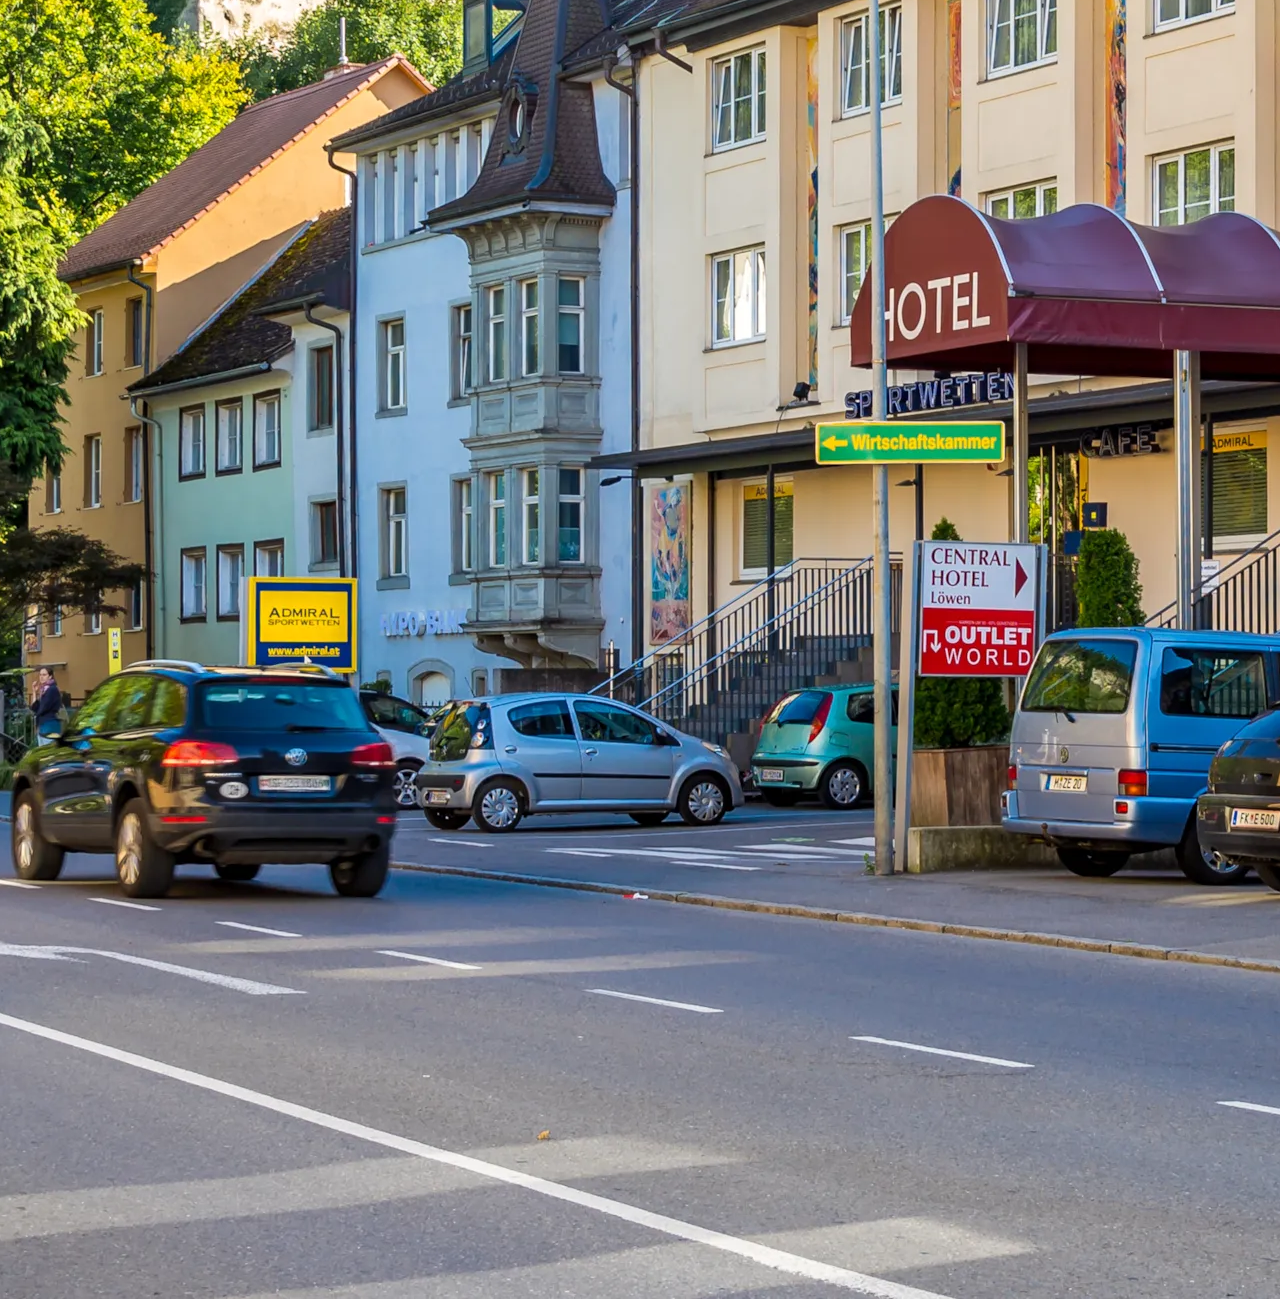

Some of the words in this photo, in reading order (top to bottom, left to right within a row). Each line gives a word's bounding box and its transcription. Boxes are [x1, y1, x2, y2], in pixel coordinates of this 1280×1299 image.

[844, 372, 1015, 419] SPRTWETTEN
[851, 433, 997, 451] Wirtschaftskammer
[1079, 424, 1153, 458] CAFE
[930, 547, 1012, 567] CENTRAL
[931, 569, 990, 588] HOTEL
[930, 590, 972, 605] Löwen
[268, 607, 341, 619] ADMIRAL
[944, 625, 1032, 646] OUTLET
[267, 646, 341, 657] www.admiral.at
[944, 647, 1031, 666] WORLD
